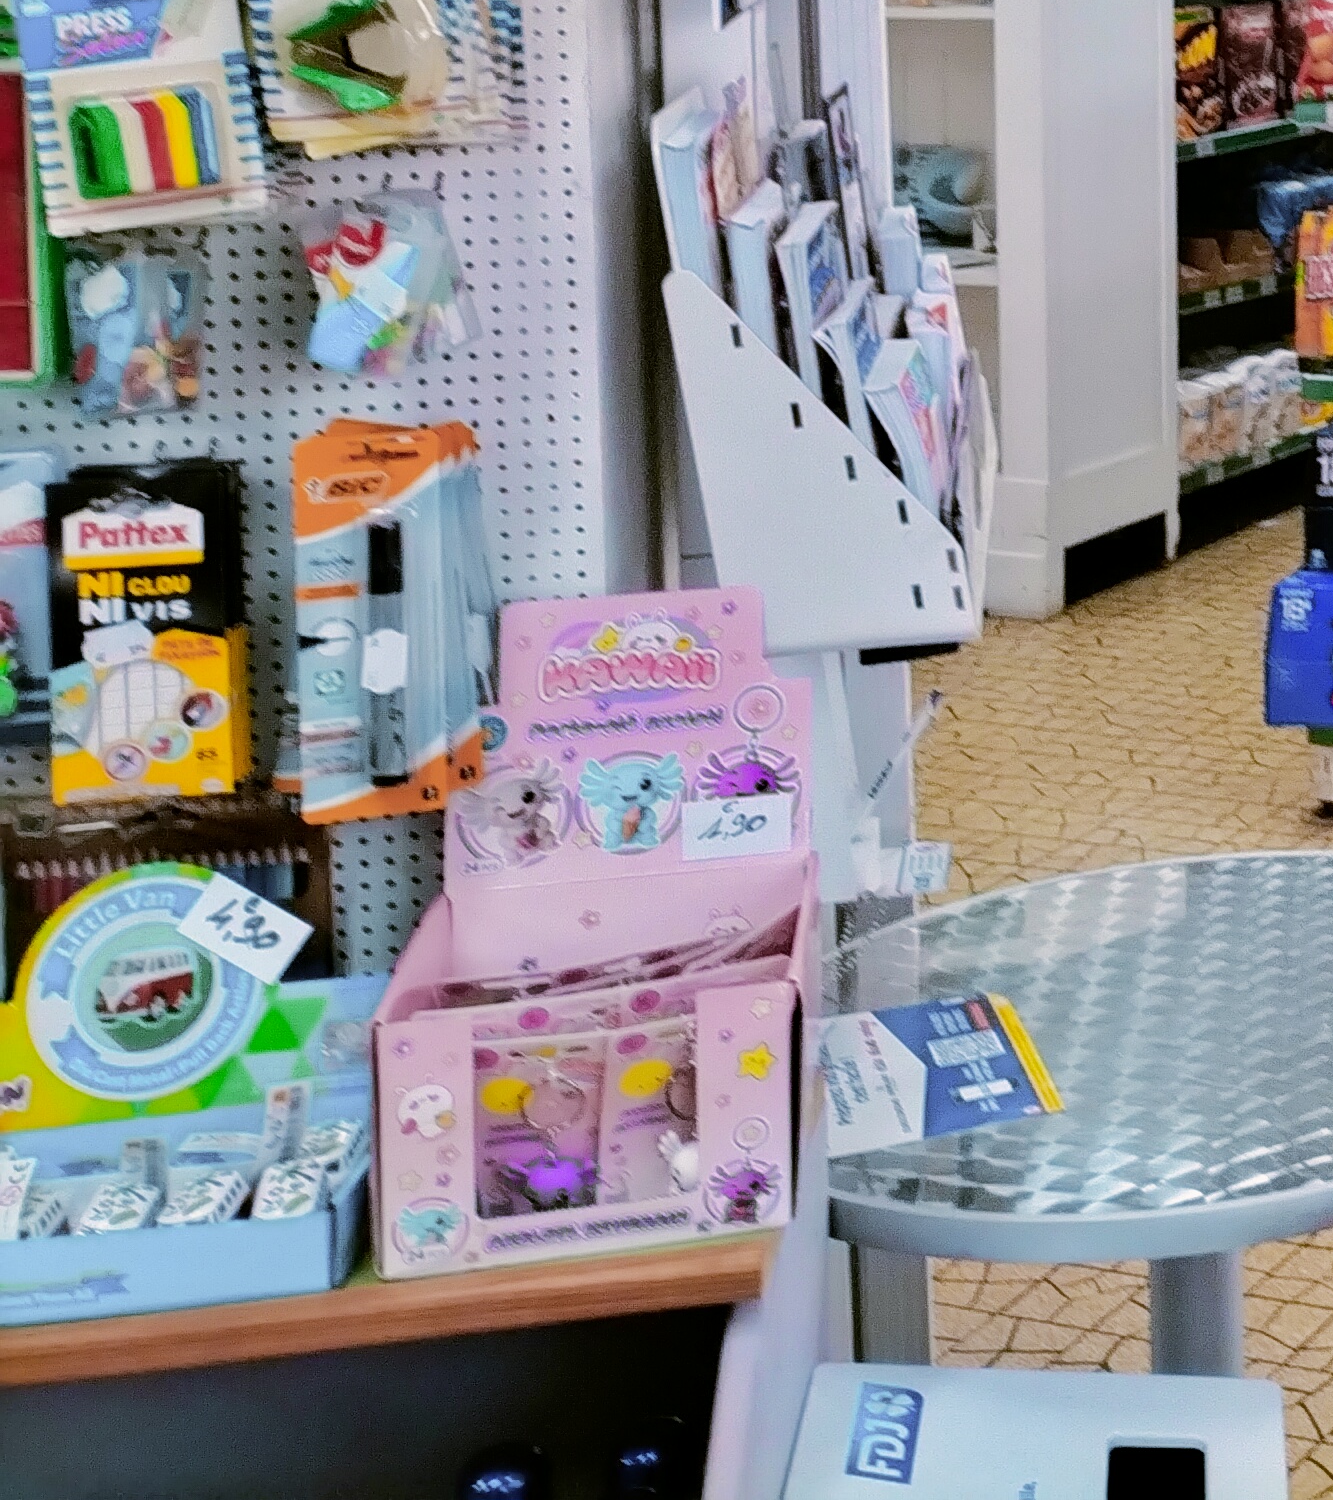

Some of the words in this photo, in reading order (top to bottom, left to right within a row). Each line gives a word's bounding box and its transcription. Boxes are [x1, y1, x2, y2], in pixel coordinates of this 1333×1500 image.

[77, 520, 191, 550] Pattex
[76, 570, 126, 600] NI
[126, 572, 192, 597] CLOU
[77, 598, 127, 627] NI
[52, 900, 122, 960] Little
[122, 888, 179, 912] Van
[855, 1417, 911, 1479] FDJ
